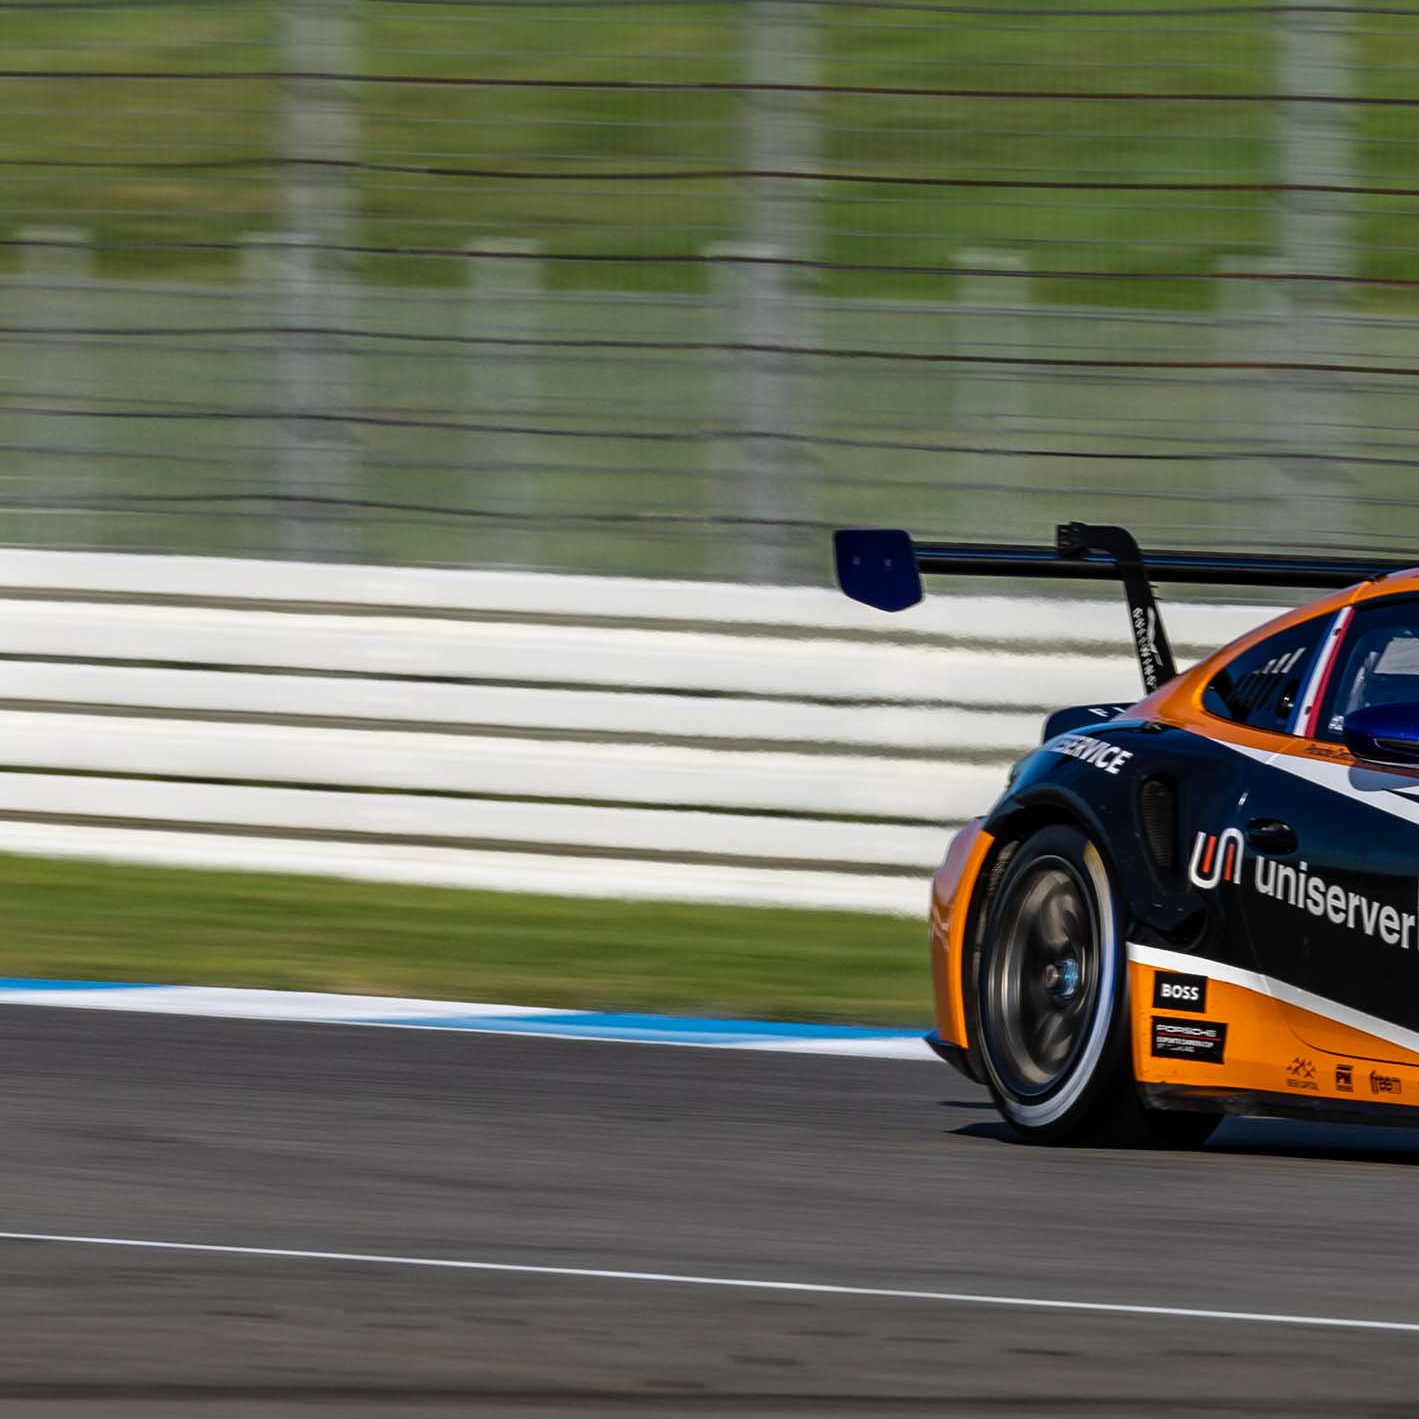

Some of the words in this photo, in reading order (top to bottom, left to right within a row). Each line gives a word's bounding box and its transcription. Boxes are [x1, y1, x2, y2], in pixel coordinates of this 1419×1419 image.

[1254, 855, 1417, 950] uniserver
[1160, 983, 1200, 1001] BOSS
[1156, 1024, 1217, 1038] PORSCHE
